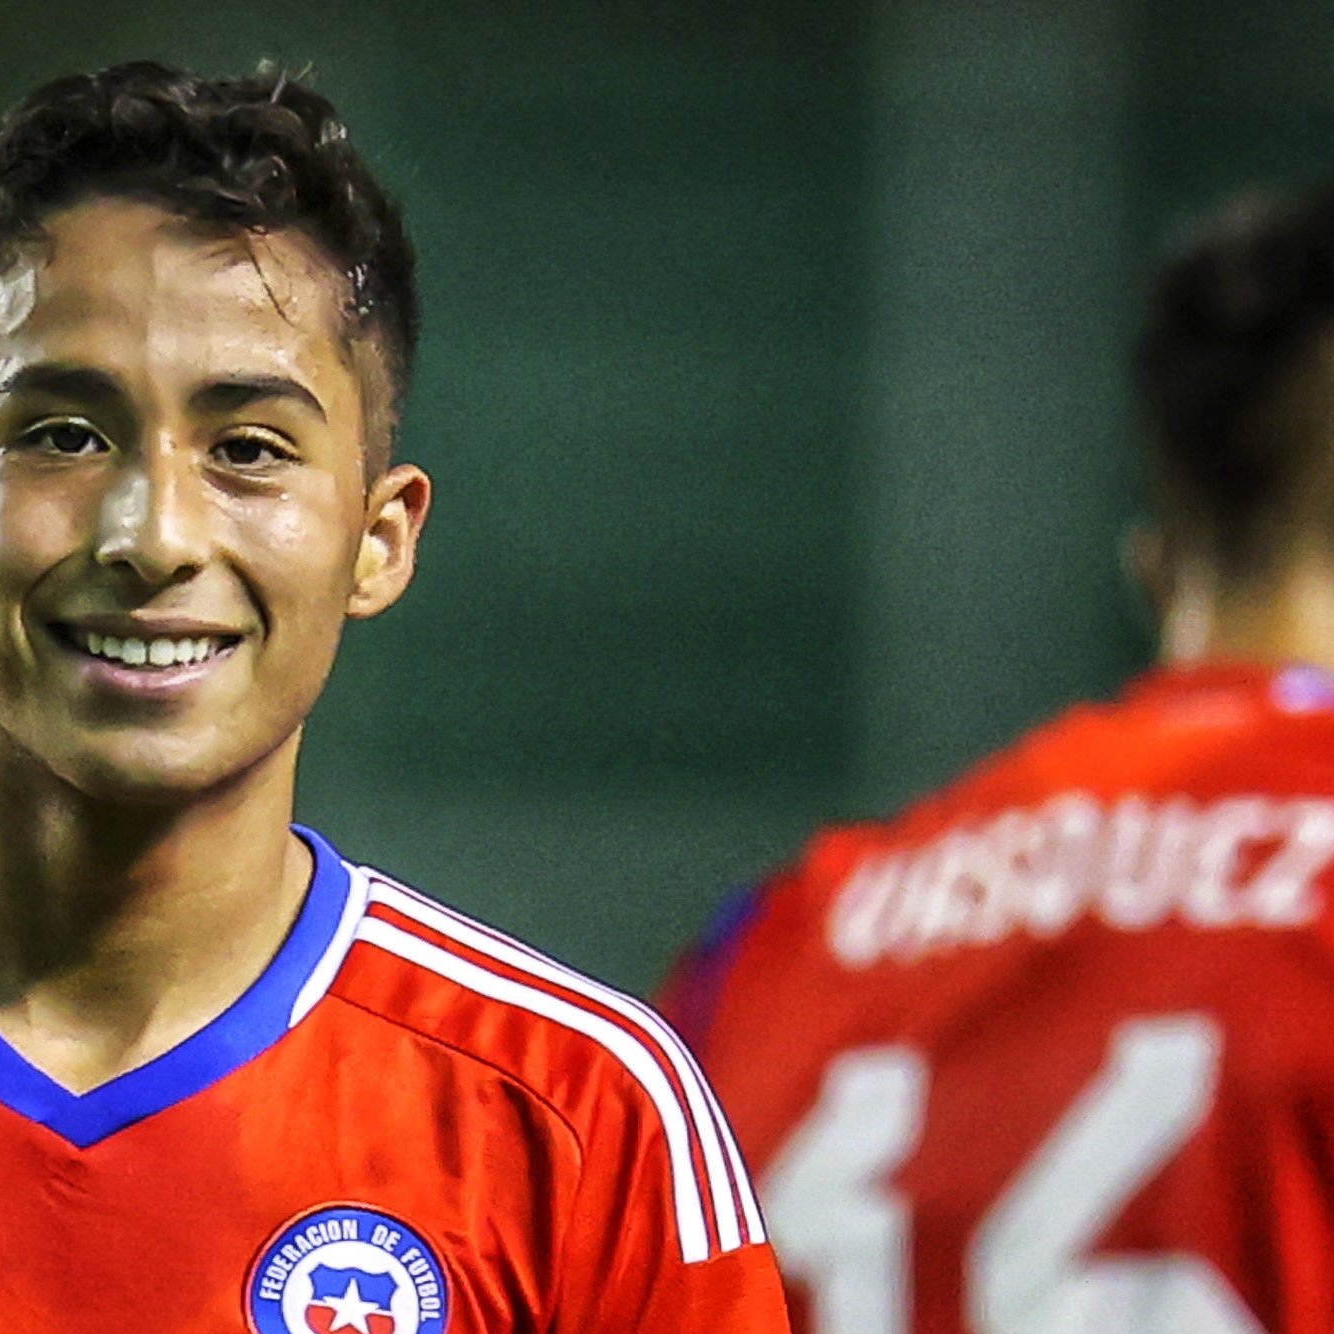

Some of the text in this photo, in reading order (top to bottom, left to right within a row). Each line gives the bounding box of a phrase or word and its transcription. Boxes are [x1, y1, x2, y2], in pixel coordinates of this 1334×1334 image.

[259, 1219, 442, 1322] FEDERACION DE FUTBOL
